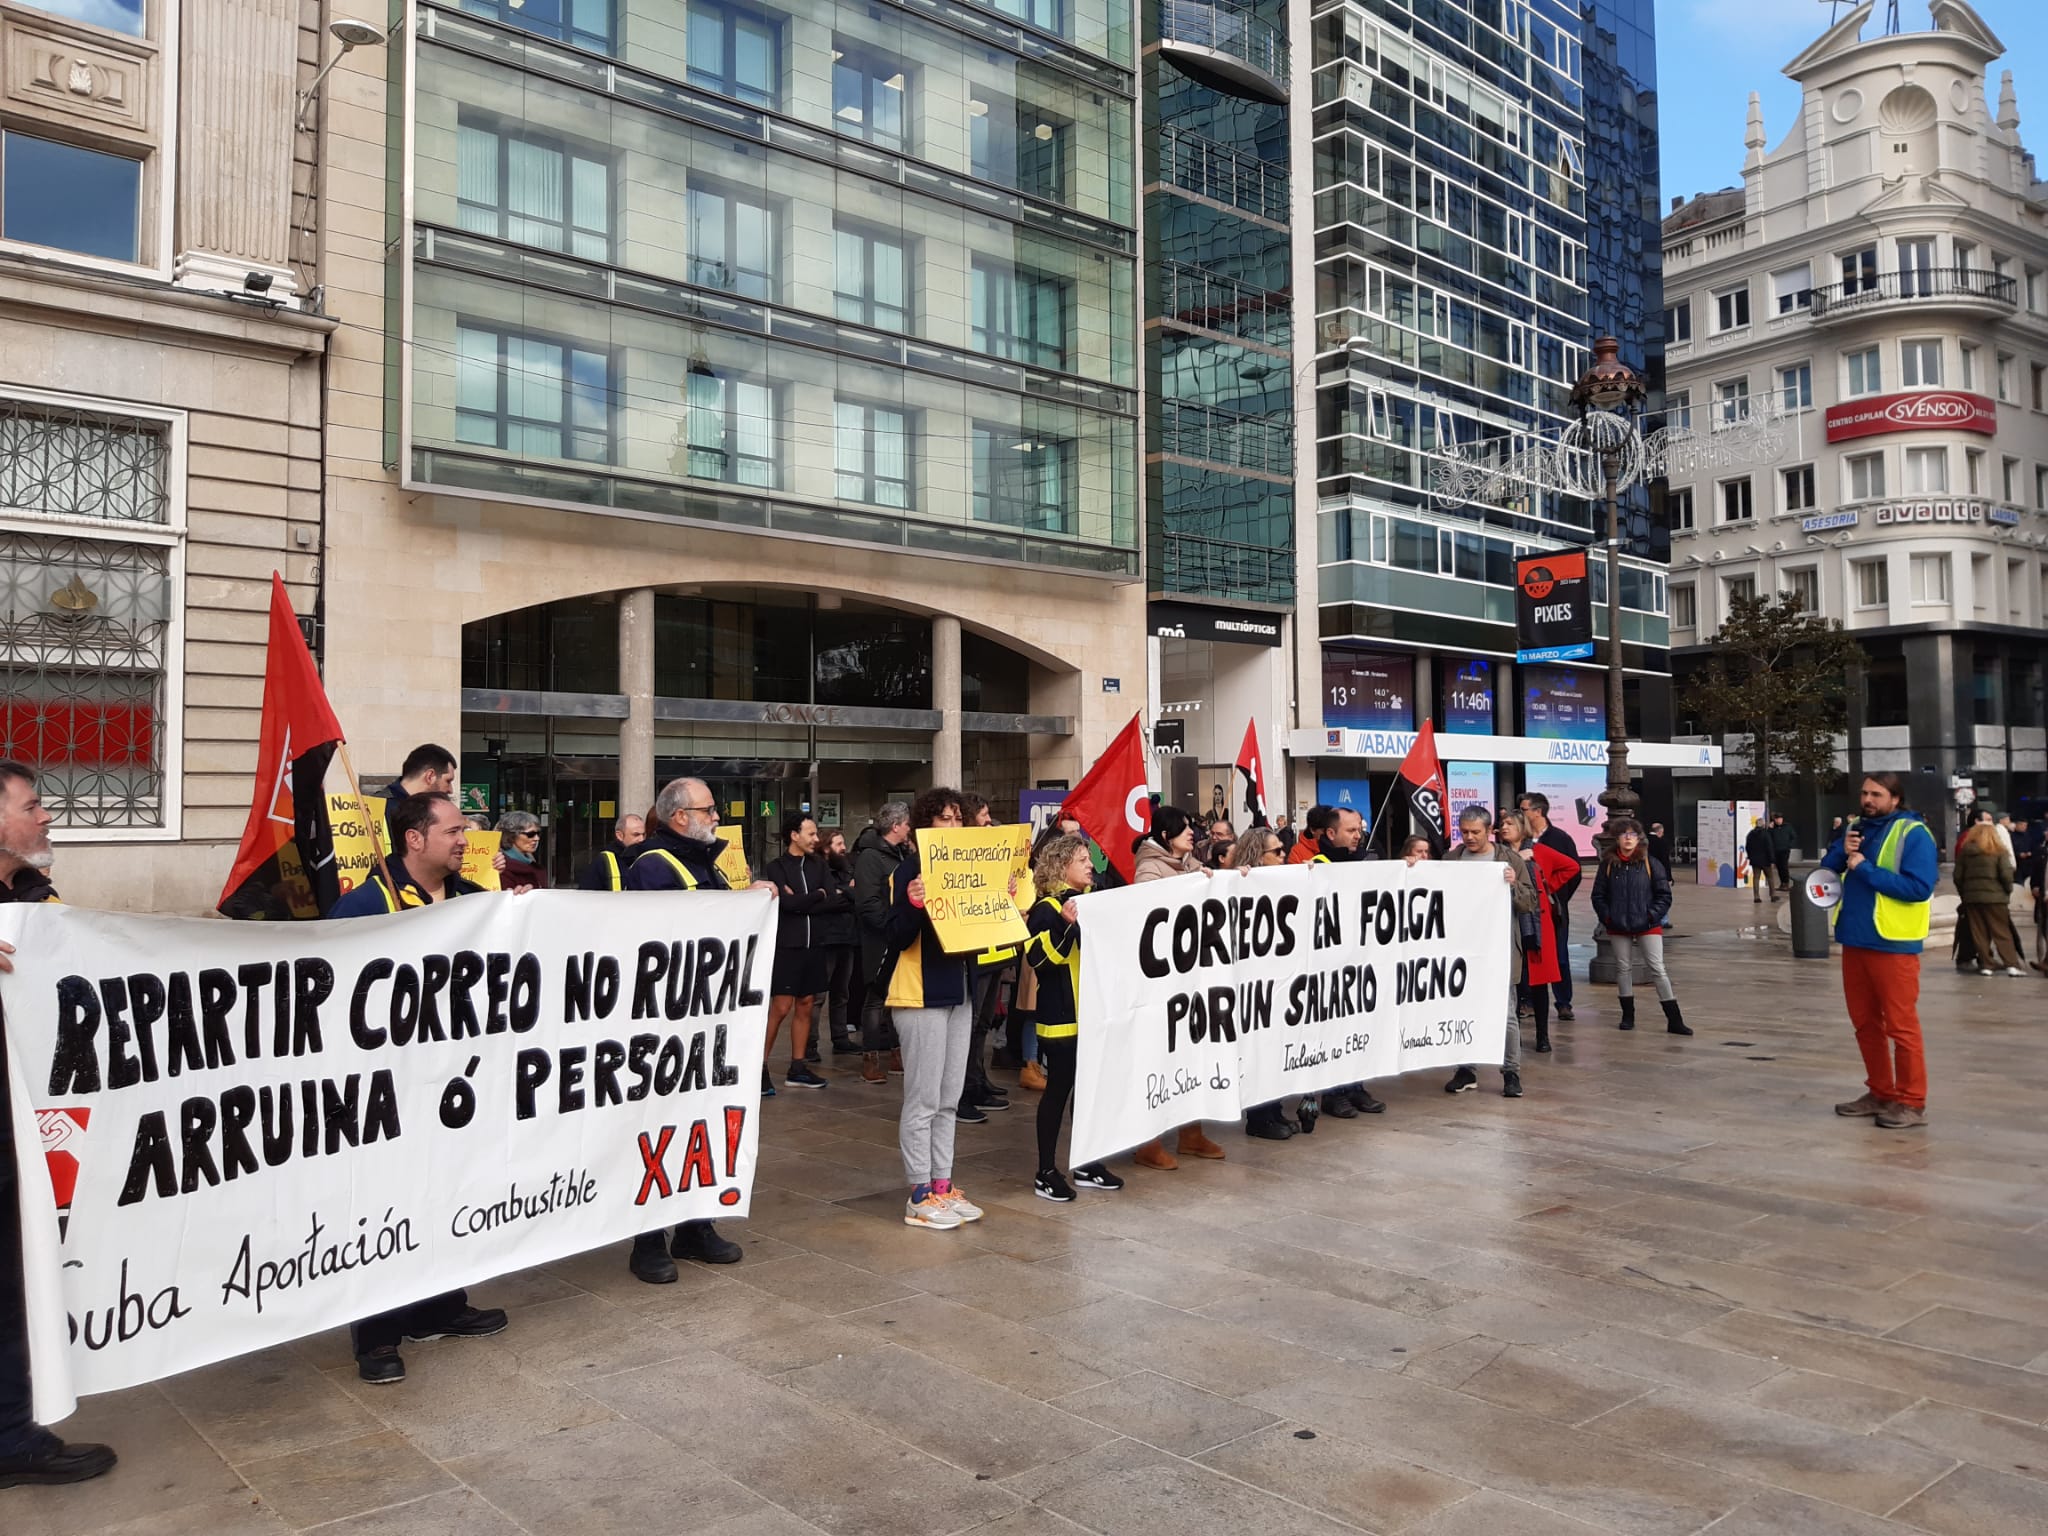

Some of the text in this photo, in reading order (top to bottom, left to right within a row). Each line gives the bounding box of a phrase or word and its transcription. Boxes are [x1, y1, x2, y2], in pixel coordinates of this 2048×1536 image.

[1828, 410, 1884, 428] CENTRO CAPILAR
[1895, 395, 1968, 420] SVENSON
[1804, 512, 1856, 529] ASESORIA
[1878, 503, 1981, 521] avante
[1534, 603, 1572, 624] PIXIES
[1529, 650, 1559, 660] MARZO
[1451, 690, 1490, 711] 11:46h
[776, 704, 841, 724] ONCE
[1450, 788, 1479, 799] SERVICIO
[952, 840, 1011, 873] recuperación
[926, 896, 957, 921] 28N
[1314, 891, 1342, 951] EN
[1360, 887, 1446, 947] FOLGA
[1284, 963, 1377, 1027] SALARIO
[1396, 956, 1467, 1006] DIGNO
[48, 934, 764, 1096] REPARTIR CORREO NO RURAL
[1283, 1041, 1329, 1072] Inclusión
[1331, 1047, 1343, 1061] no
[1145, 1073, 1171, 1111] Pola
[1172, 1067, 1202, 1096] Suba
[1209, 1061, 1231, 1090] do
[117, 1068, 402, 1207] ARRUINA
[516, 1024, 739, 1121] PERSOAL
[634, 1105, 747, 1206] XA!
[222, 1207, 420, 1314] Aportación
